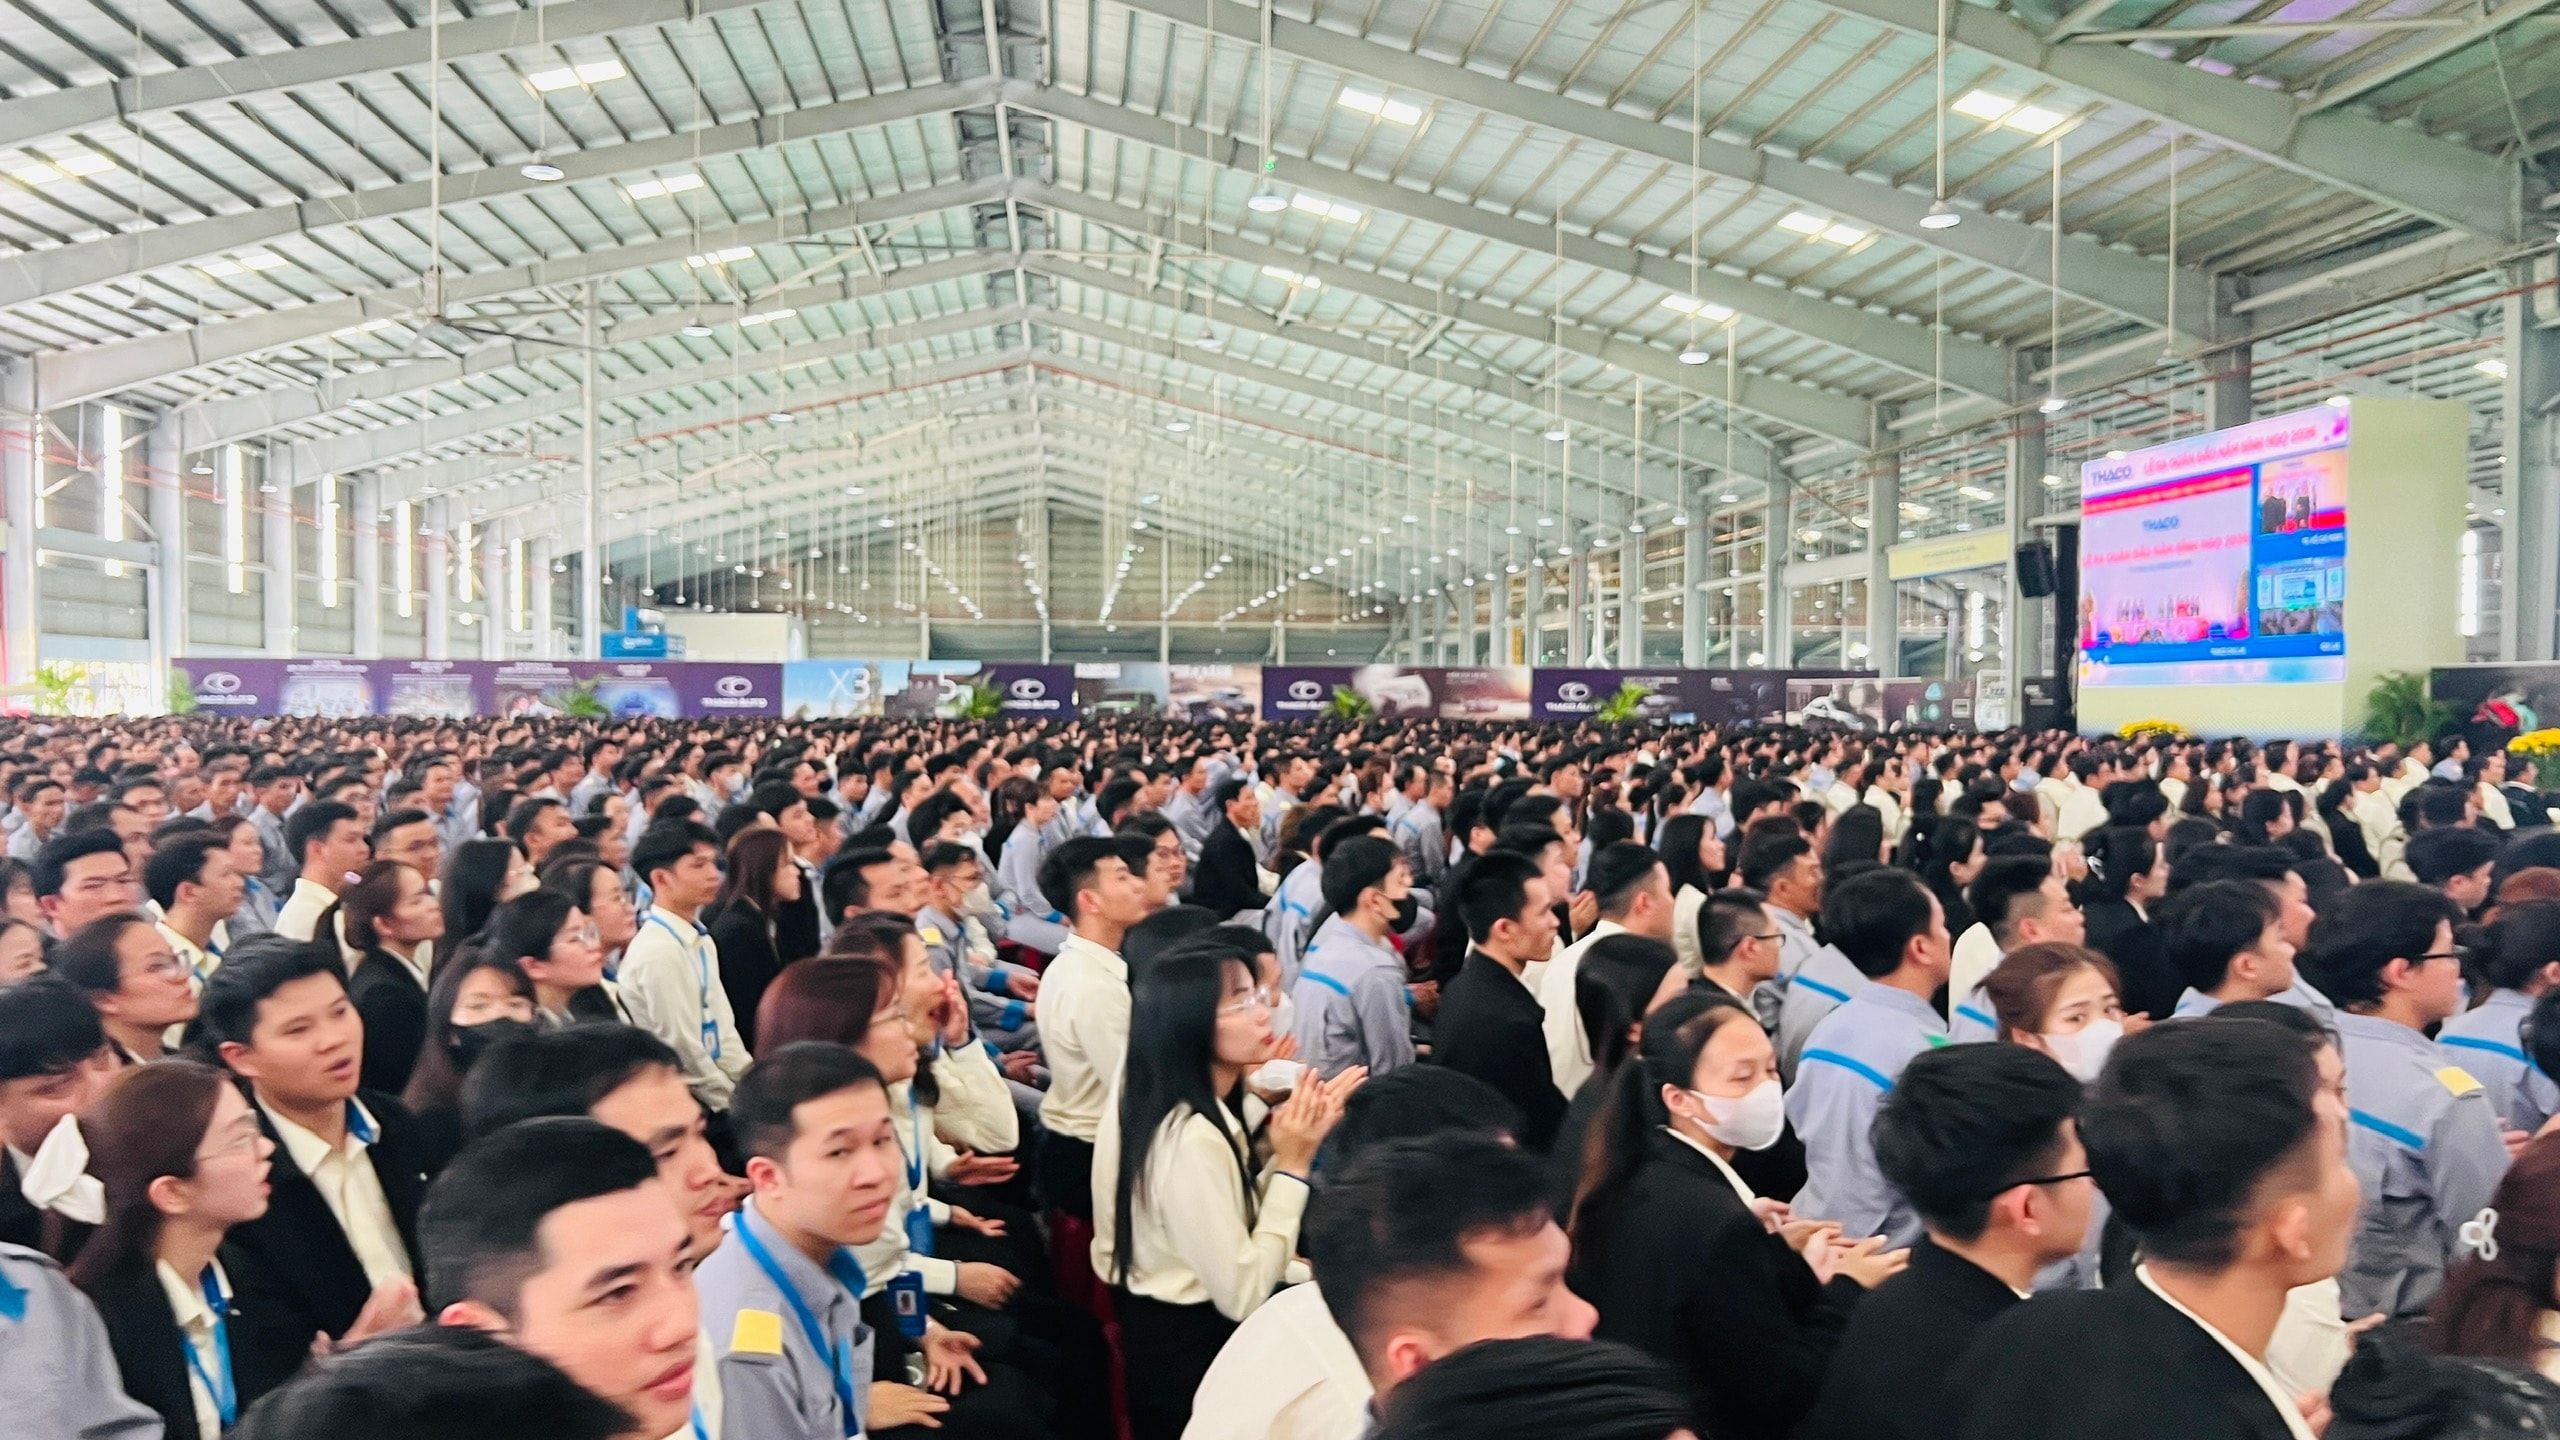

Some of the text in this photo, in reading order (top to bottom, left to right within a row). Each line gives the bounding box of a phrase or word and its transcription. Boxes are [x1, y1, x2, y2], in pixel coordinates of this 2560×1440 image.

[2091, 465, 2132, 484] THACO
[2143, 515, 2179, 532] THACO
[828, 667, 871, 701] X3
[1545, 702, 1577, 712] THACO
